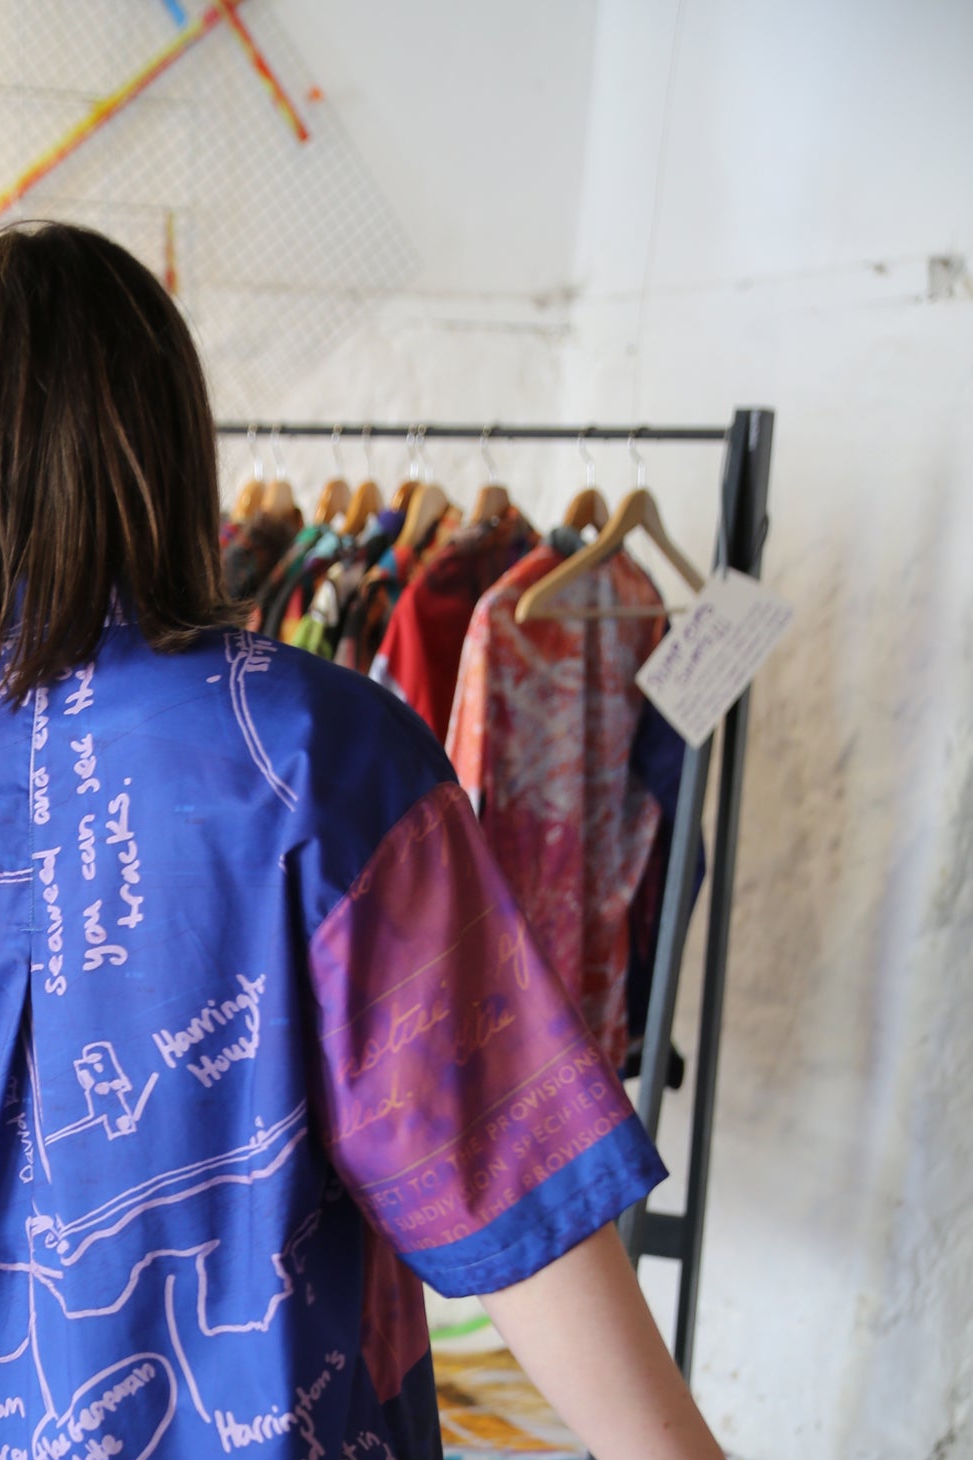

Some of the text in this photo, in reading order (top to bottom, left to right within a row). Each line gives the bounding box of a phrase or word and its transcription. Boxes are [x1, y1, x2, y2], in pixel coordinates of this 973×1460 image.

[70, 733, 101, 794] see
[79, 814, 96, 880] can
[82, 899, 128, 972] you
[409, 1169, 438, 1196] TO
[485, 1046, 602, 1140] PROVISIONS
[511, 1080, 607, 1160] SPECIFIED
